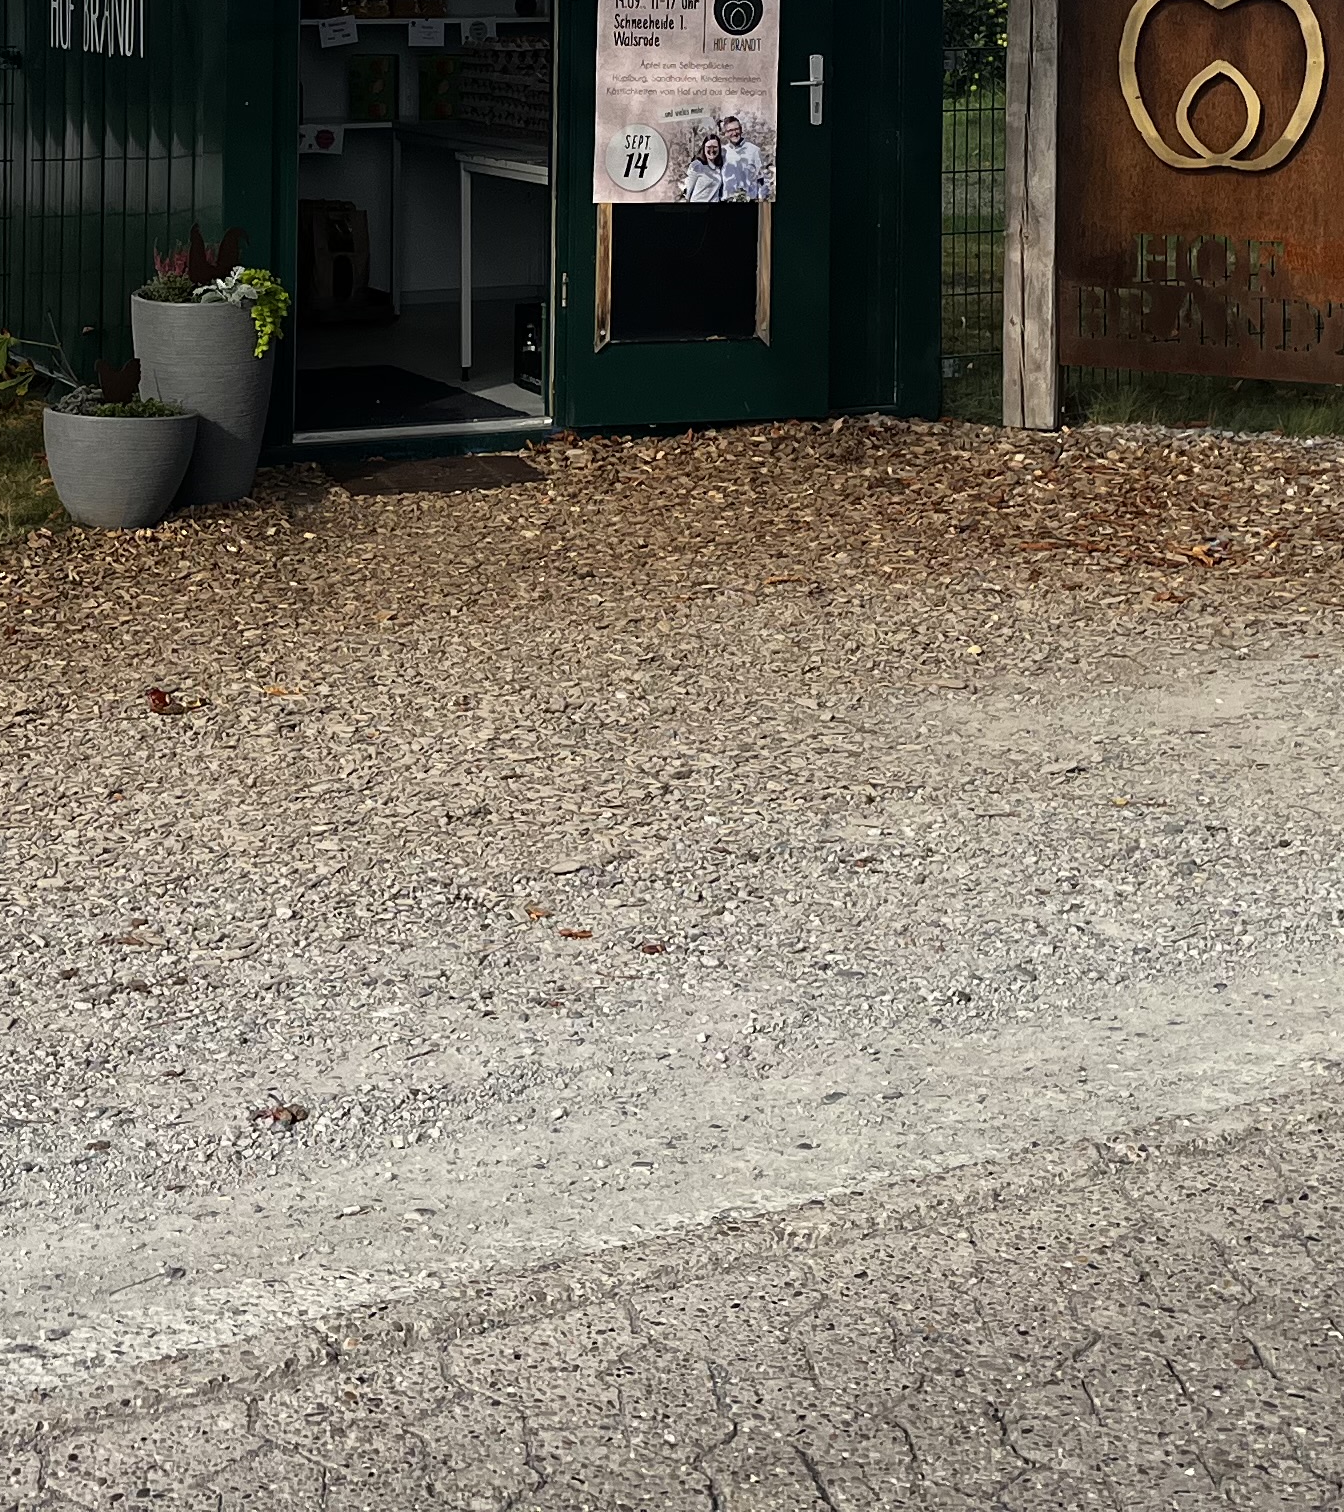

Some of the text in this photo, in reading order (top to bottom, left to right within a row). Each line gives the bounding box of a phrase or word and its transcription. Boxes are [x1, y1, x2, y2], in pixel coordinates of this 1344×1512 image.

[614, 13, 675, 30] Schneeheide
[613, 31, 660, 47] Walsrode
[714, 38, 762, 52] HOF BRANDT
[623, 152, 650, 178] 14
[1134, 232, 1285, 291] HOF
